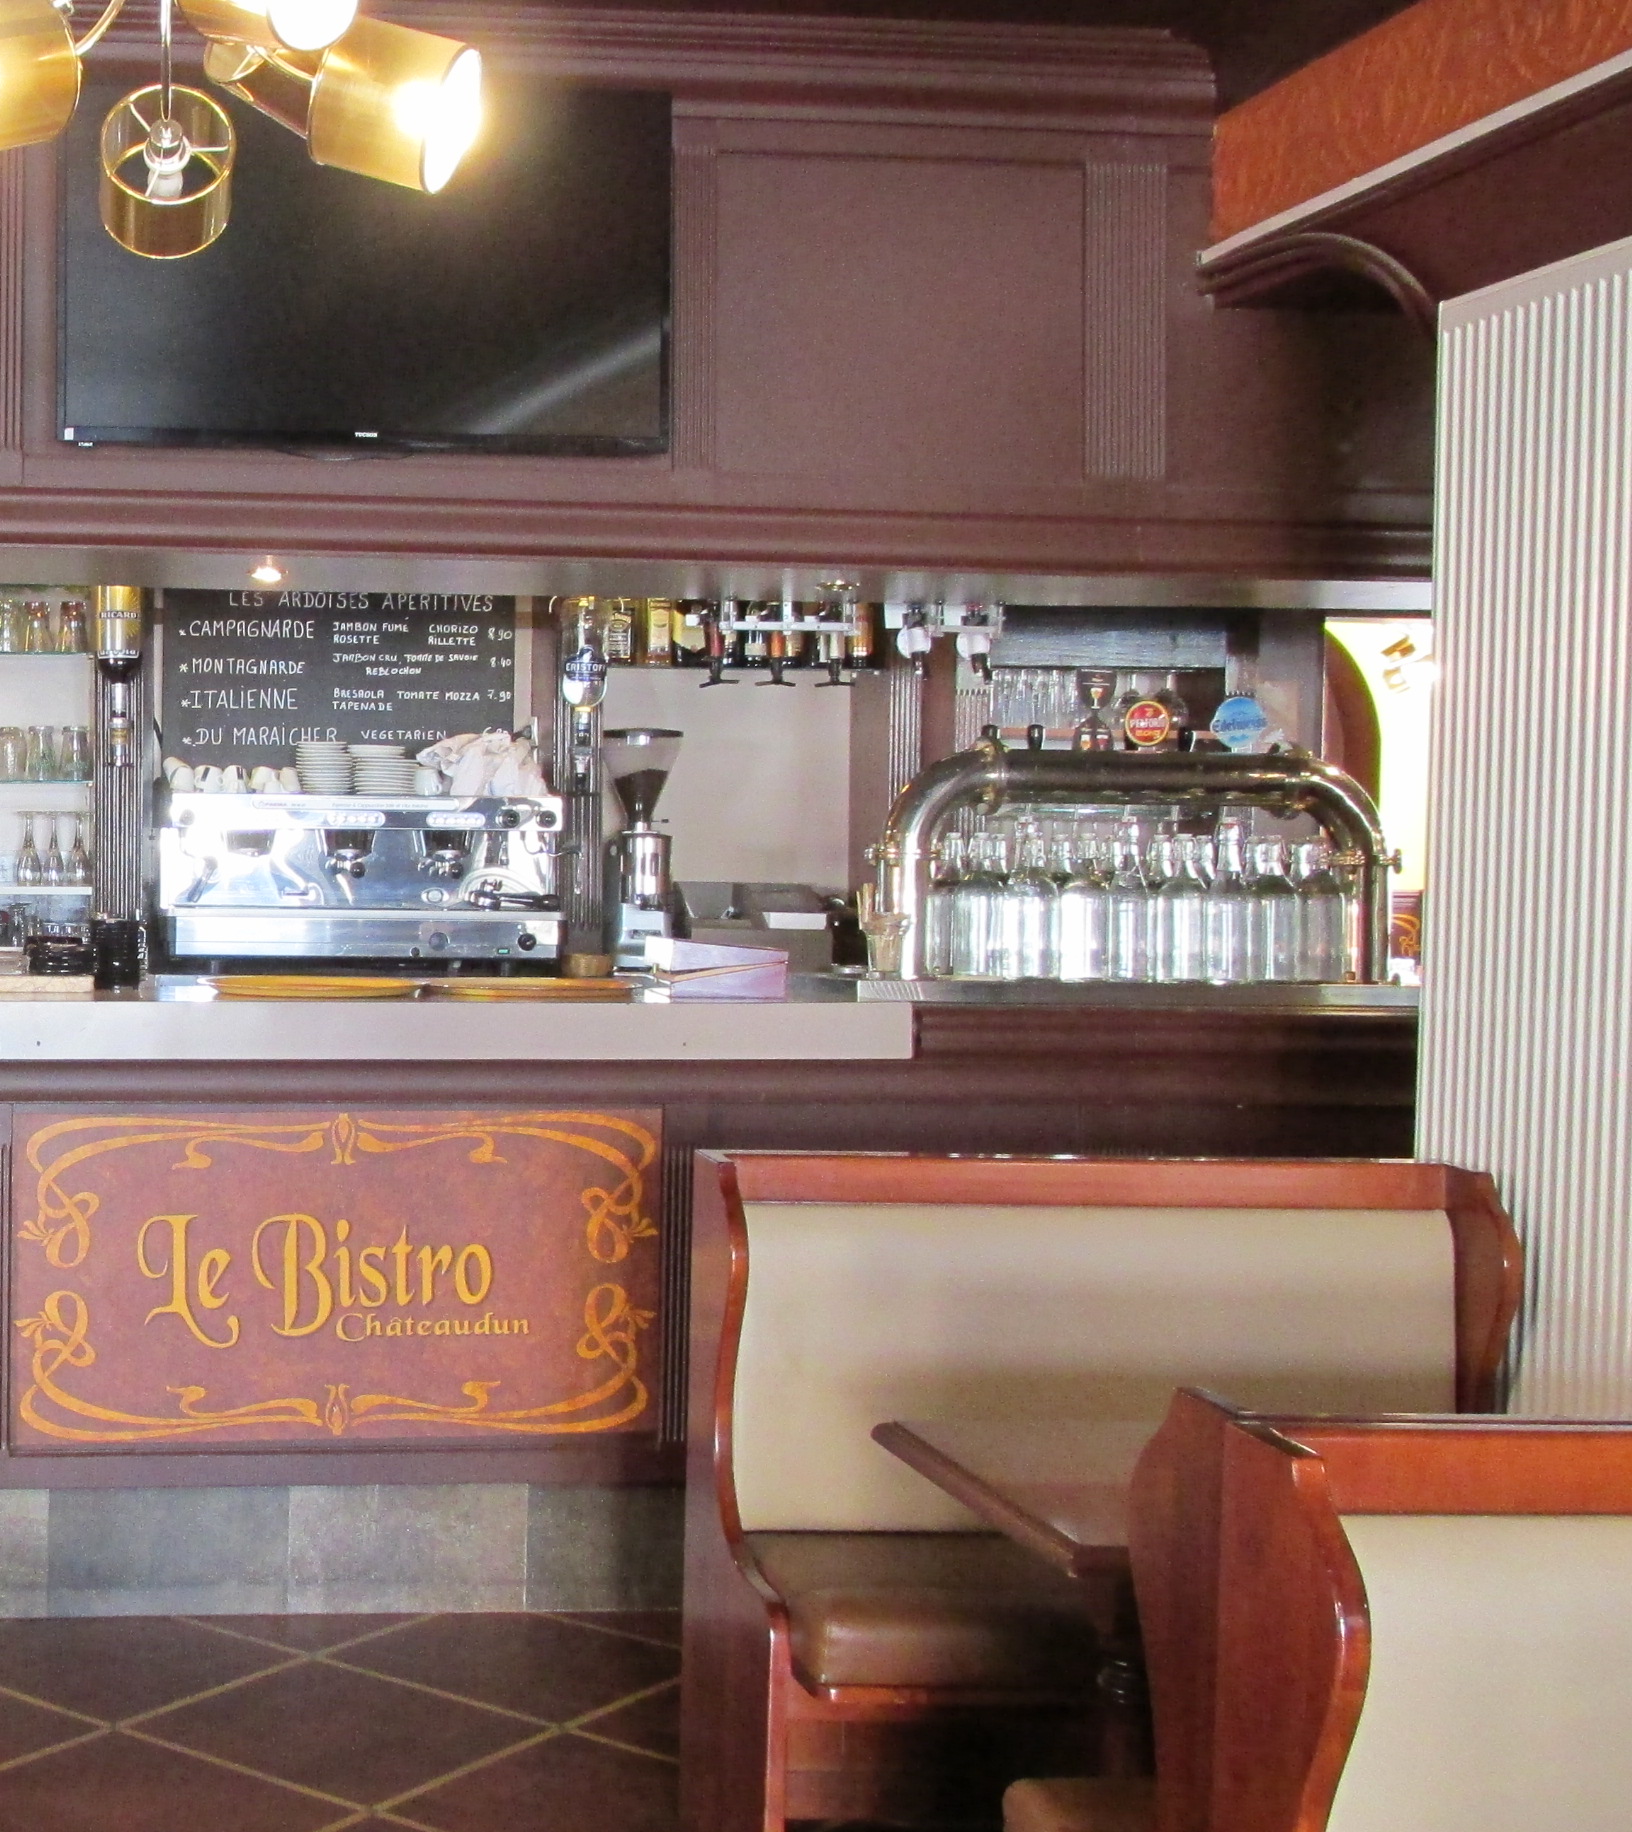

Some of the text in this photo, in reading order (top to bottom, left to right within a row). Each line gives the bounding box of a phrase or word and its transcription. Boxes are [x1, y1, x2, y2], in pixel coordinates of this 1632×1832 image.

[228, 591, 494, 613] LES ARDOISES APERITIVES
[100, 611, 137, 619] RICARD
[189, 619, 316, 639] CAMPAGNARDE
[332, 621, 378, 633] JAMBON
[382, 616, 410, 633] FUMÉ
[428, 623, 479, 634] CHORIZO
[333, 634, 477, 646] ROSETTE RILLETTE
[191, 657, 306, 675] MONTAGNARDE
[434, 654, 445, 663] DE
[365, 666, 422, 676] REBLOCHON
[190, 684, 299, 710] ITALIENNE
[333, 687, 385, 699] BRESAOLA
[396, 690, 440, 700] TOMATE
[444, 690, 481, 701] MOZZA
[332, 700, 394, 712] TAPENADE
[194, 722, 338, 746] DU MARAICHER
[360, 727, 447, 741] VEGETARIEN
[137, 1212, 494, 1349] Le Bistro
[335, 1311, 530, 1343] Châteaudun
